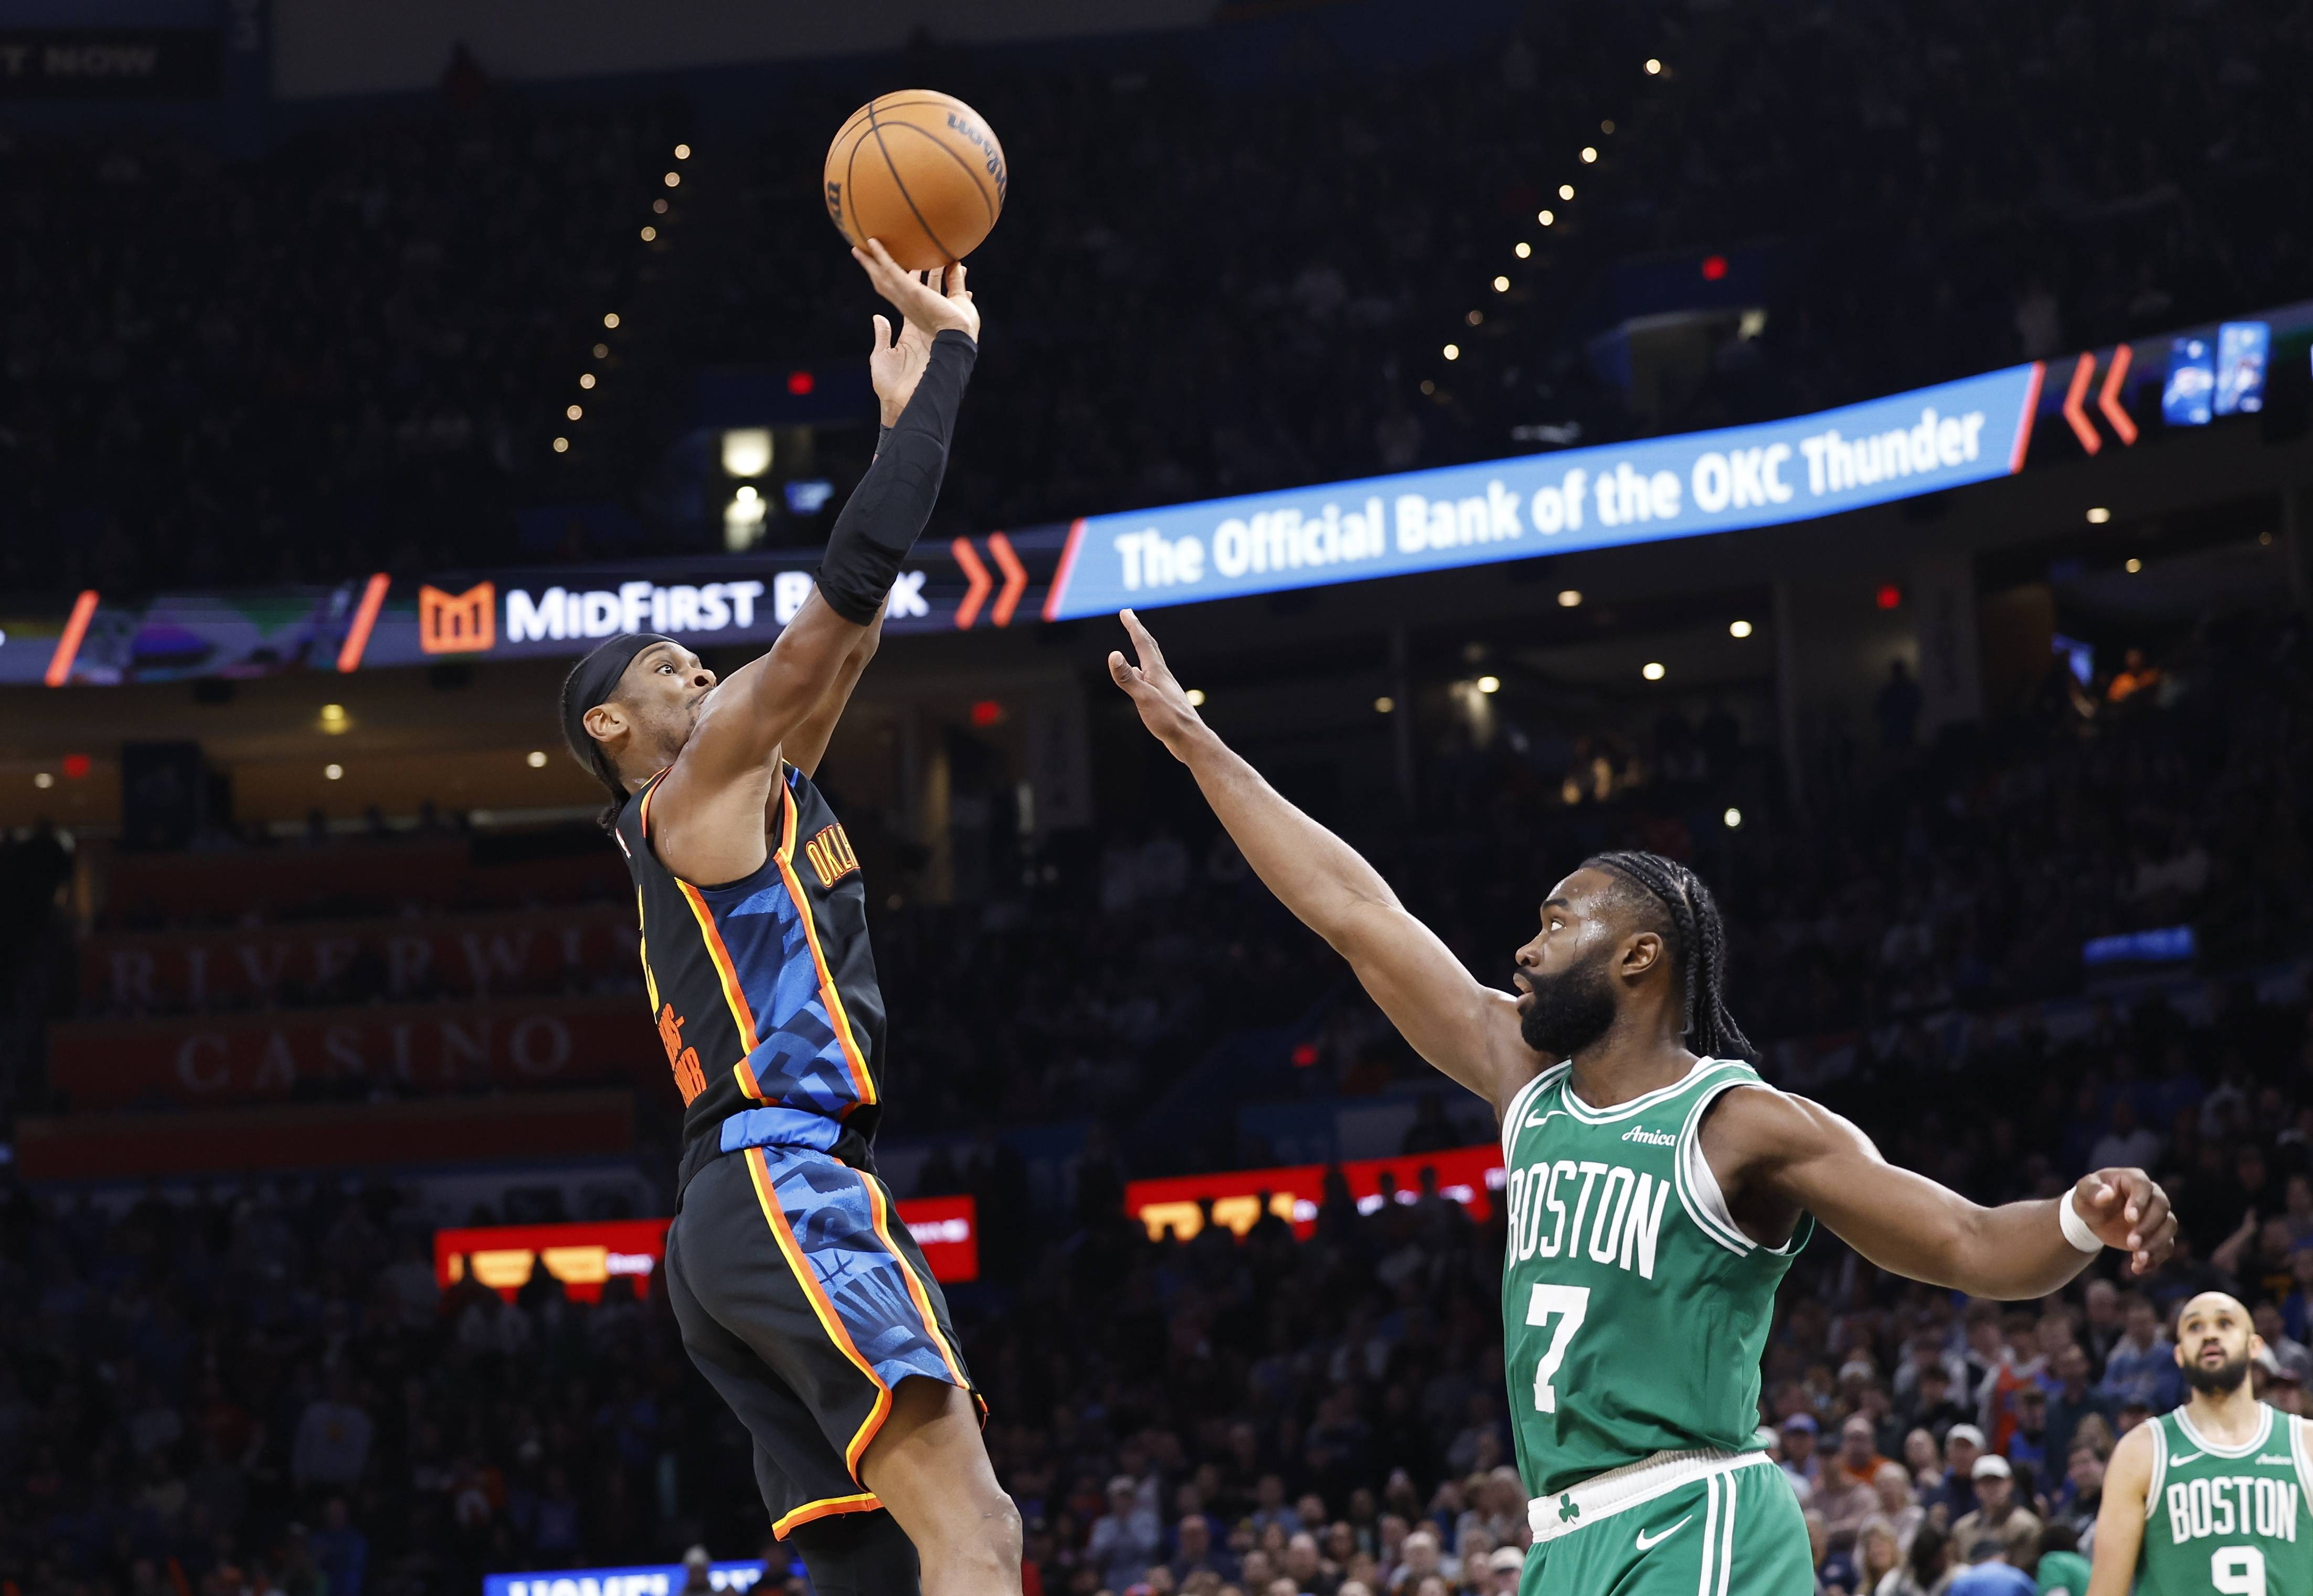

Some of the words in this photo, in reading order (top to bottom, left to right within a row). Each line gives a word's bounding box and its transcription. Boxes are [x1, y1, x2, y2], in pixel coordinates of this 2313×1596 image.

[44, 44, 158, 77] NOW
[1114, 527, 1205, 591] The
[1213, 496, 1385, 578] Official
[1395, 478, 1523, 554] Bank
[1530, 467, 1587, 536] of
[1595, 461, 1681, 527] the
[1691, 442, 1794, 514] OKC
[1799, 406, 1986, 497] Thunder
[773, 570, 929, 625] BK
[173, 1015, 573, 1093] CASINO
[1621, 1125, 1676, 1146] Amica
[1509, 1160, 1671, 1280] BOSTON
[1525, 1283, 1590, 1413] 7
[2167, 1476, 2298, 1545] BOSTON
[2211, 1545, 2267, 1596] 9
